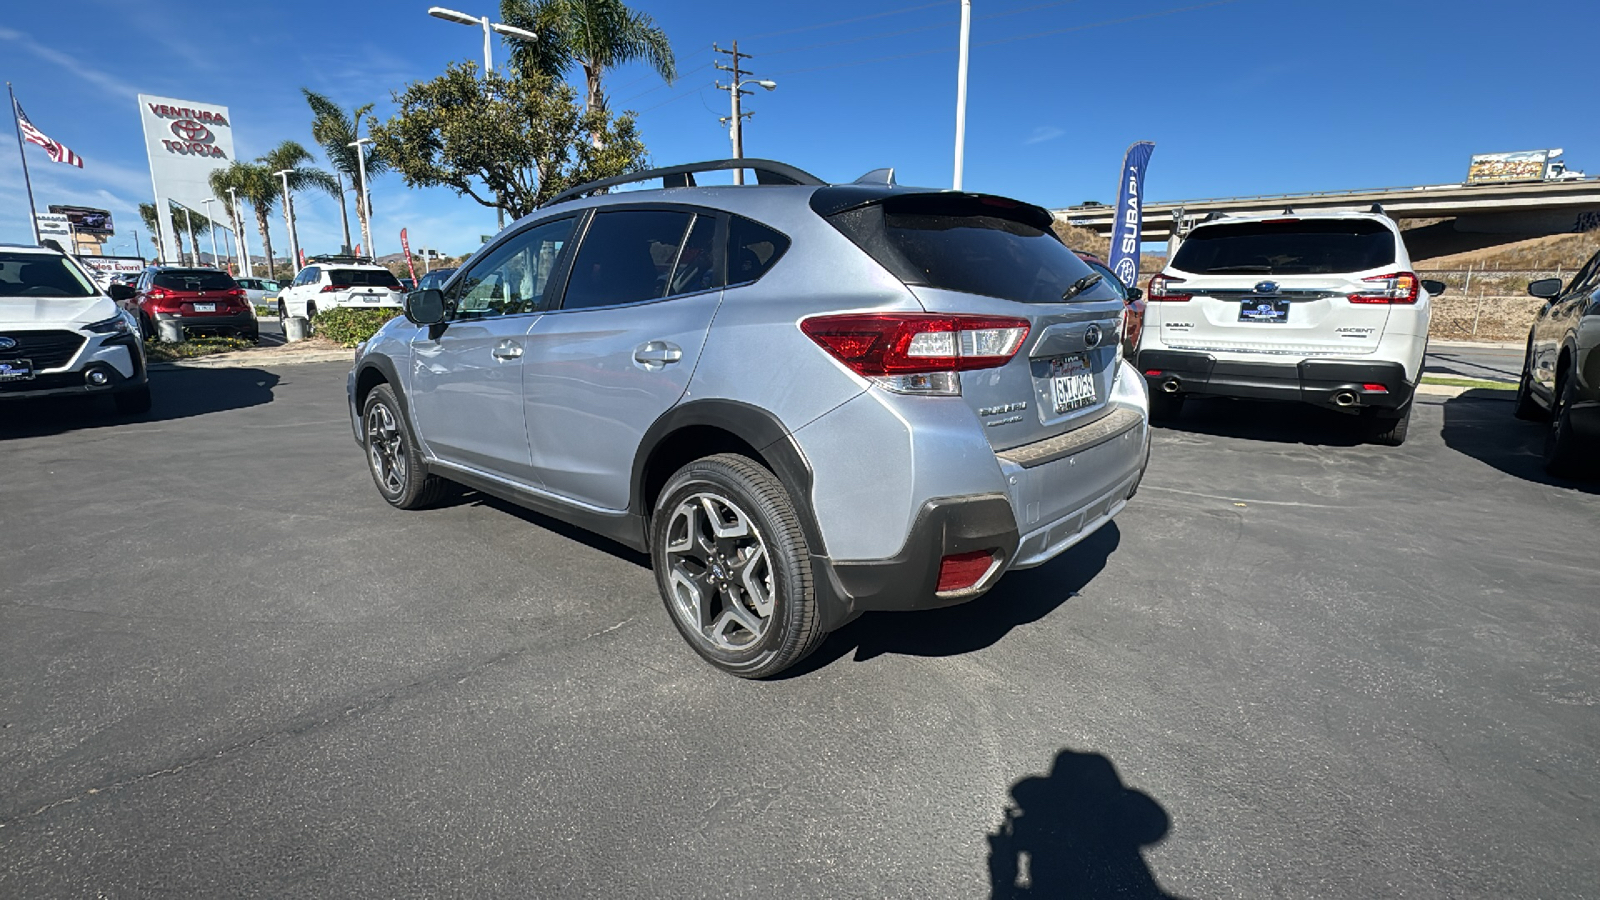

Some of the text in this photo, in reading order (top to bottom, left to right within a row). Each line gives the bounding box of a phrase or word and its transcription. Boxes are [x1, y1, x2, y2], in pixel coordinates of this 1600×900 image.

[148, 103, 225, 123] VENTURA
[162, 140, 222, 155] TOYOTA
[114, 263, 141, 271] Event
